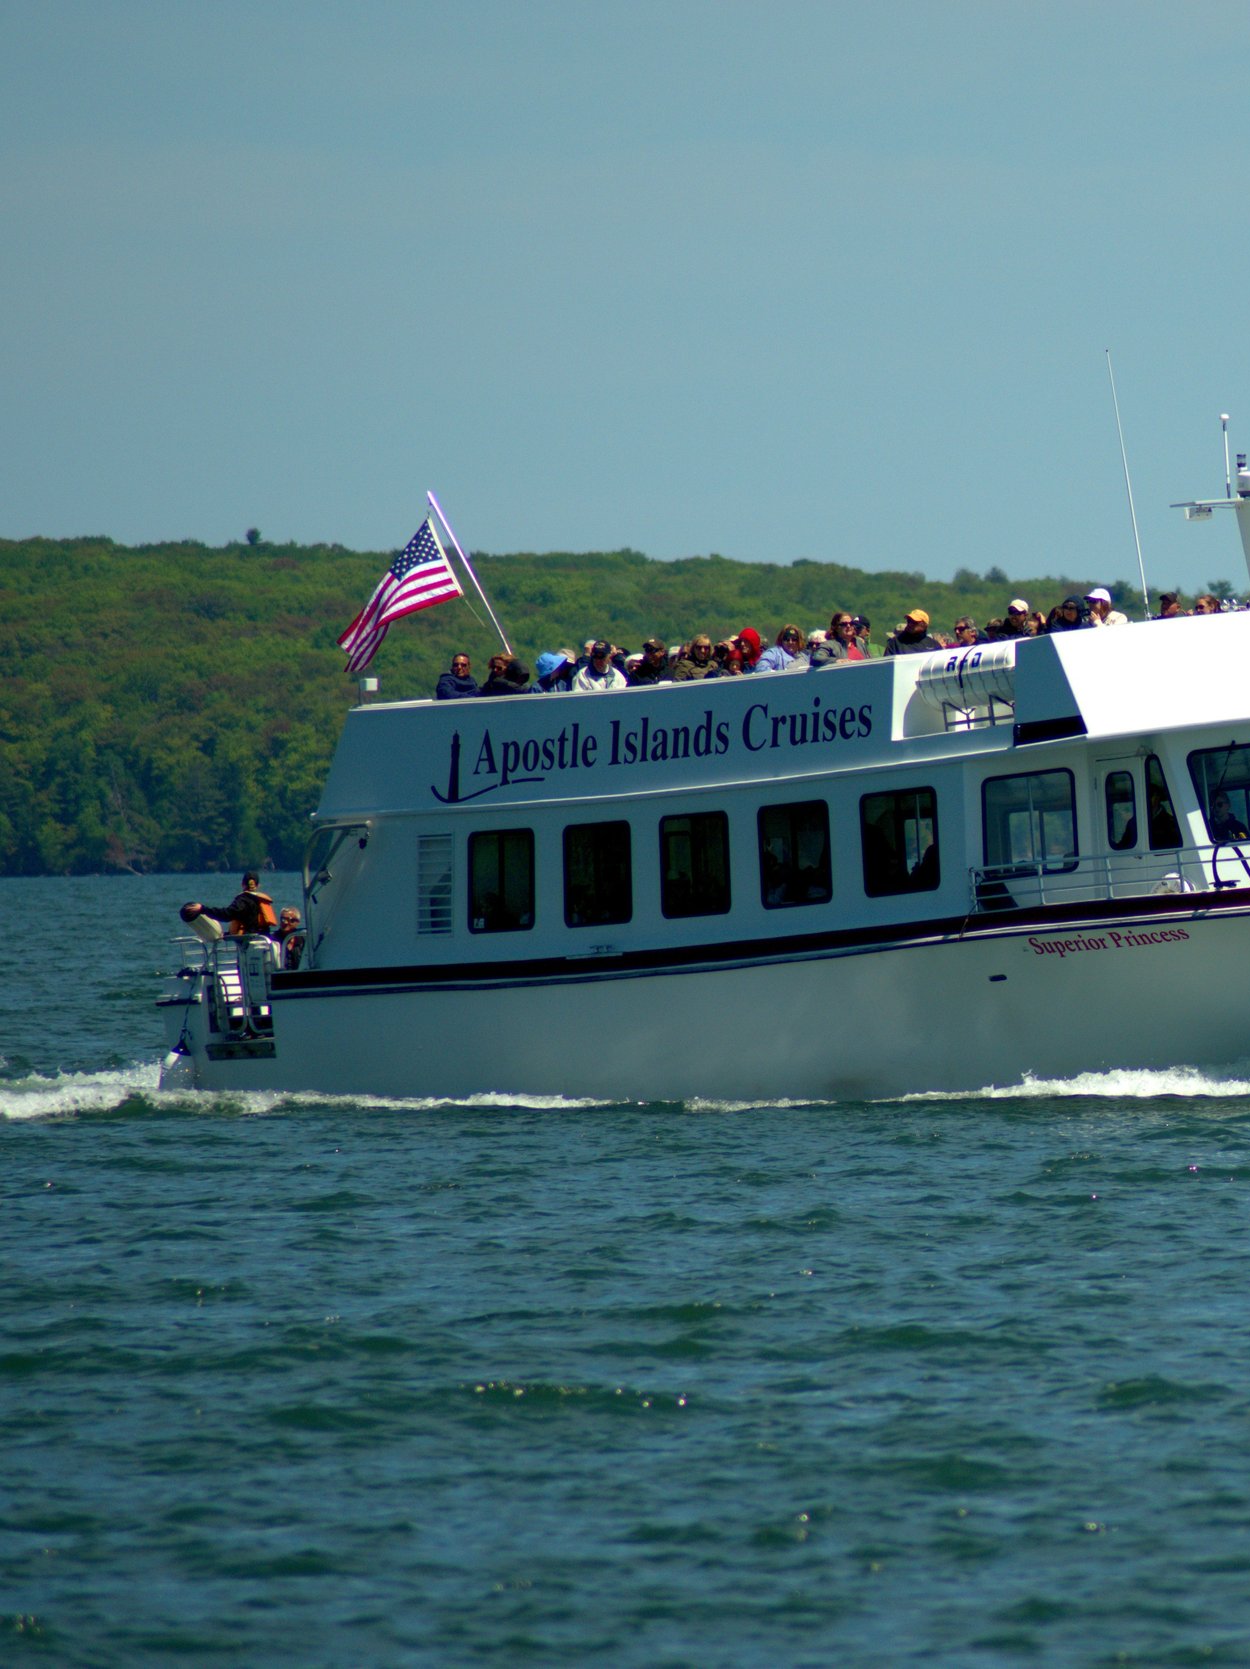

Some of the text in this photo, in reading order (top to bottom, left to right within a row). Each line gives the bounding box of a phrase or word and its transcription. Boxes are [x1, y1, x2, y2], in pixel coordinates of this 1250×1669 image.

[473, 697, 873, 786] Apostle Islands Cruises
[1028, 929, 1190, 958] Superior Princess
